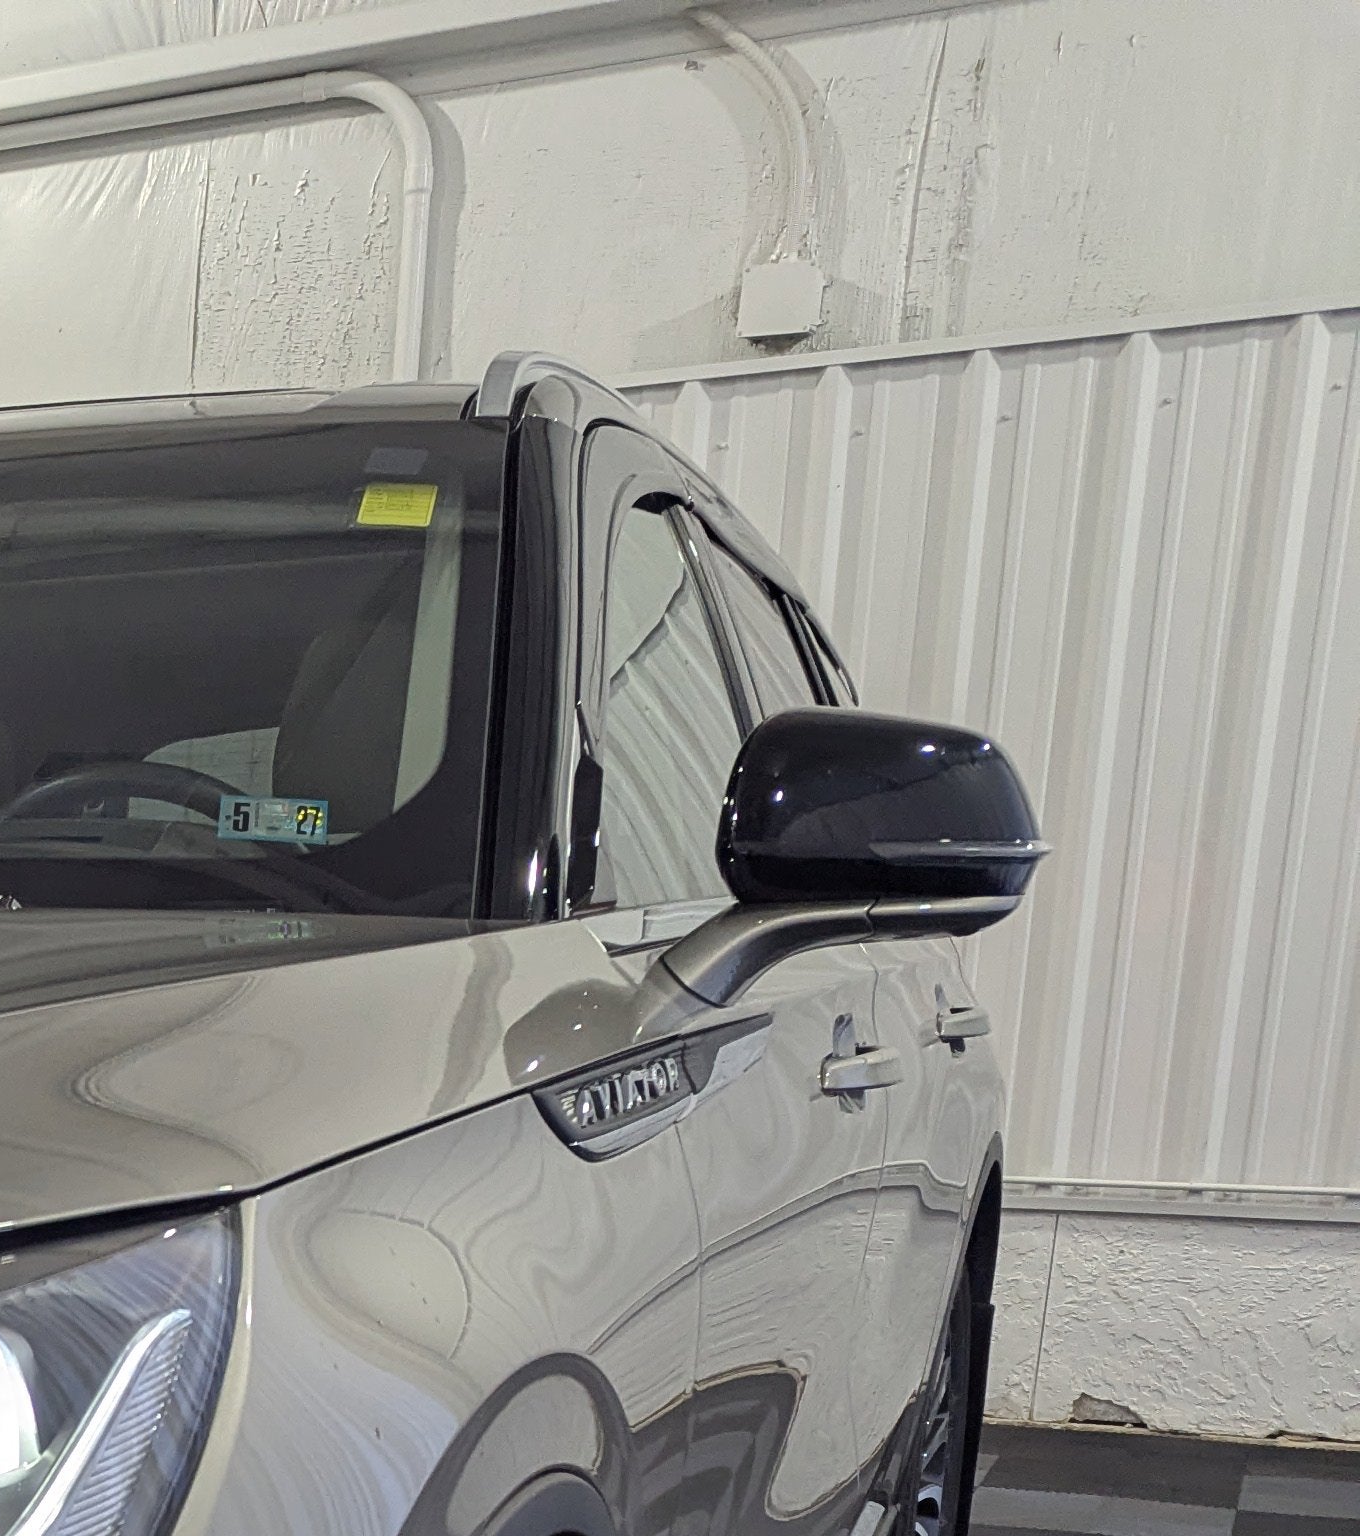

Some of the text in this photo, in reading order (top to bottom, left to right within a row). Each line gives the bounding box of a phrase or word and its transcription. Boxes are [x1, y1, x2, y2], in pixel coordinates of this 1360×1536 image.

[232, 802, 251, 832] 5
[296, 805, 322, 836] 27
[578, 1058, 680, 1128] AVIATOR
